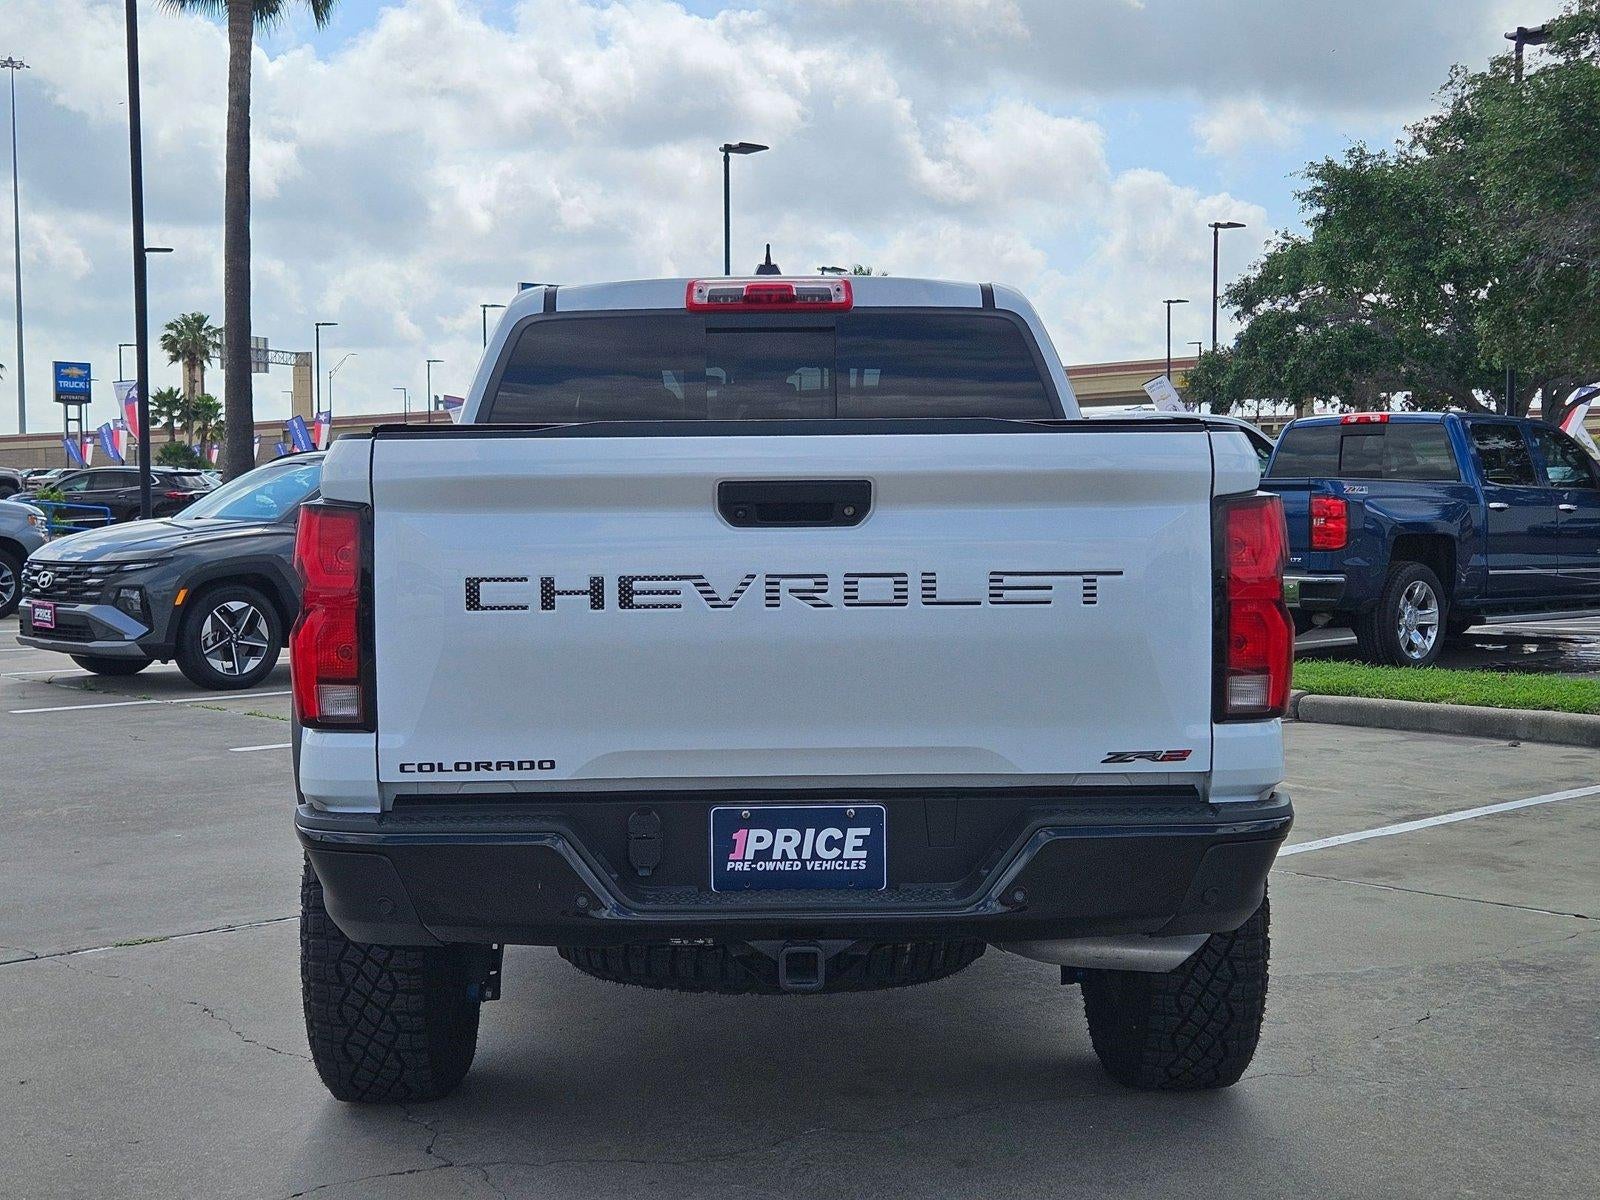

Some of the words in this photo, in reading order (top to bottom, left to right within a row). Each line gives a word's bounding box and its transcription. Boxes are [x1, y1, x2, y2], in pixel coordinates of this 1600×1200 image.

[465, 570, 1124, 612] CHEVROLET
[1100, 749, 1192, 764] ZR2
[398, 759, 556, 773] COLORADO
[728, 827, 871, 860] 1PRICE
[726, 860, 802, 872] PRE-OWNED
[806, 859, 867, 871] VEHICLES
